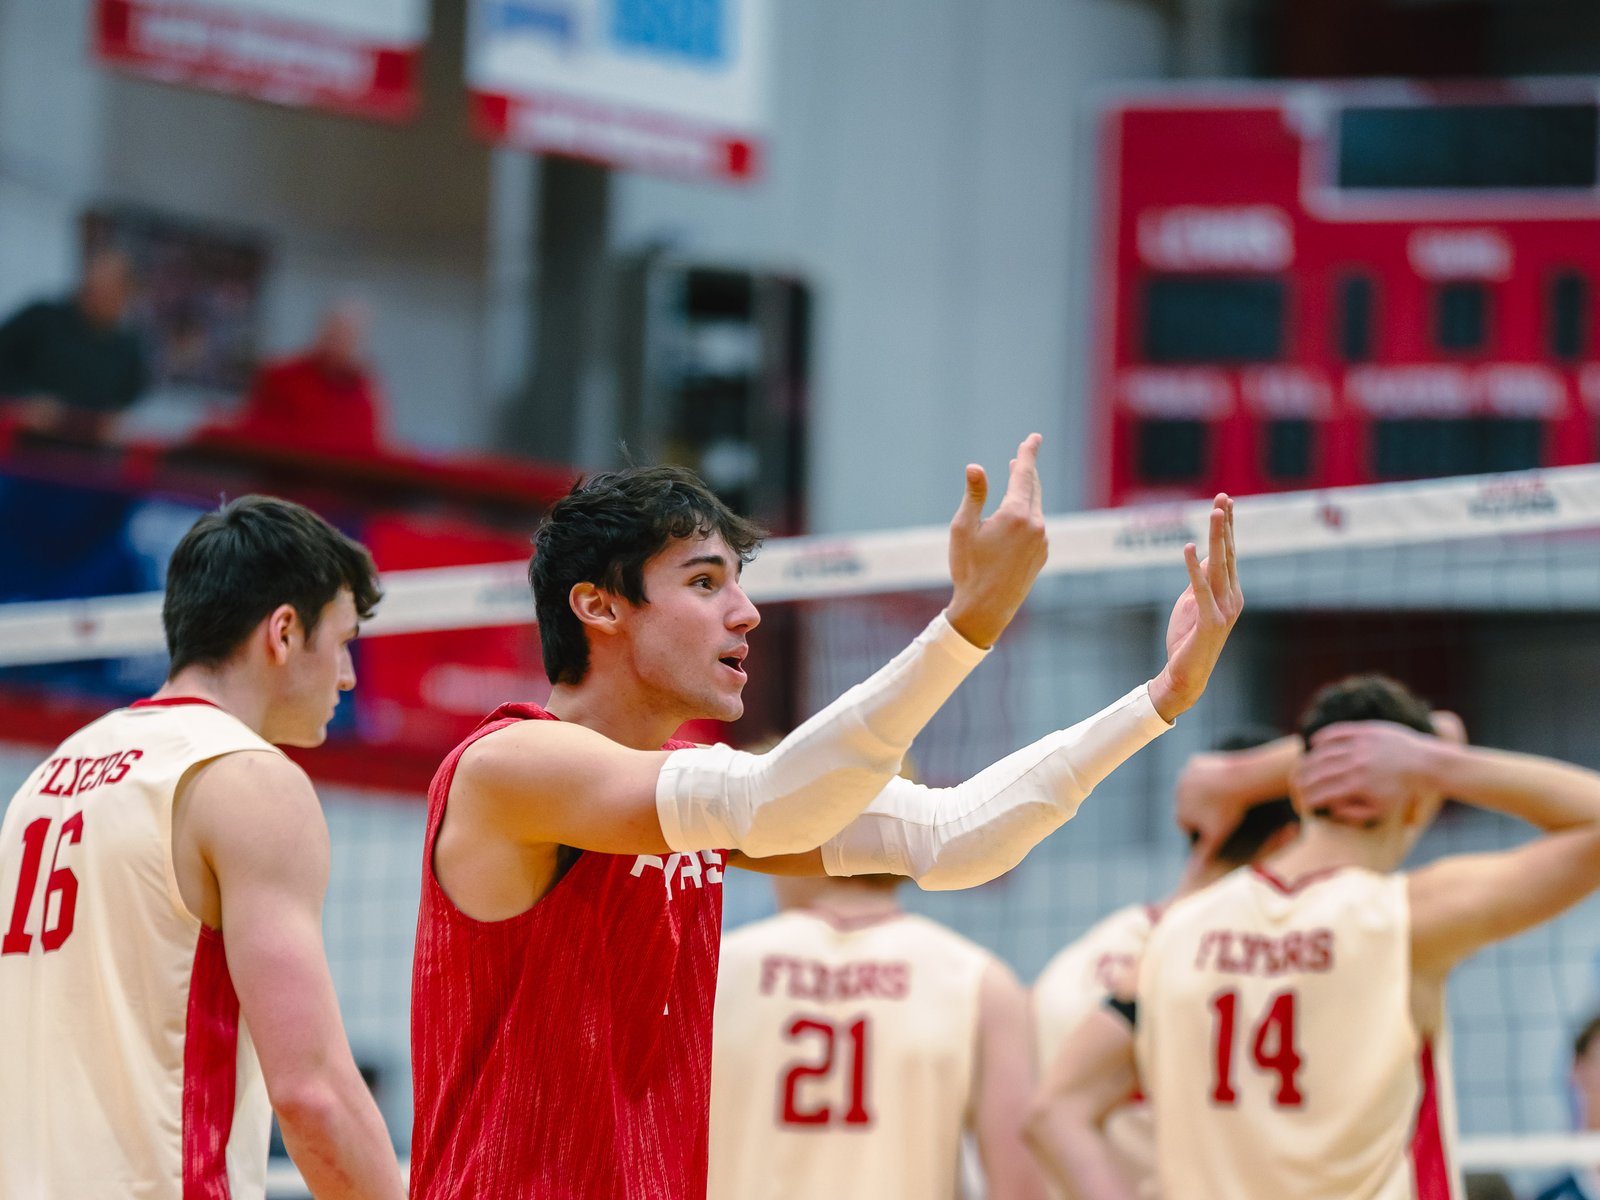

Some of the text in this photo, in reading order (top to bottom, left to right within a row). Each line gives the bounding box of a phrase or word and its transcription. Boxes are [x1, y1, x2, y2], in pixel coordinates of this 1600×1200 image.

[2, 810, 84, 956] 16
[778, 1015, 872, 1128] 21
[1210, 986, 1307, 1108] 14
